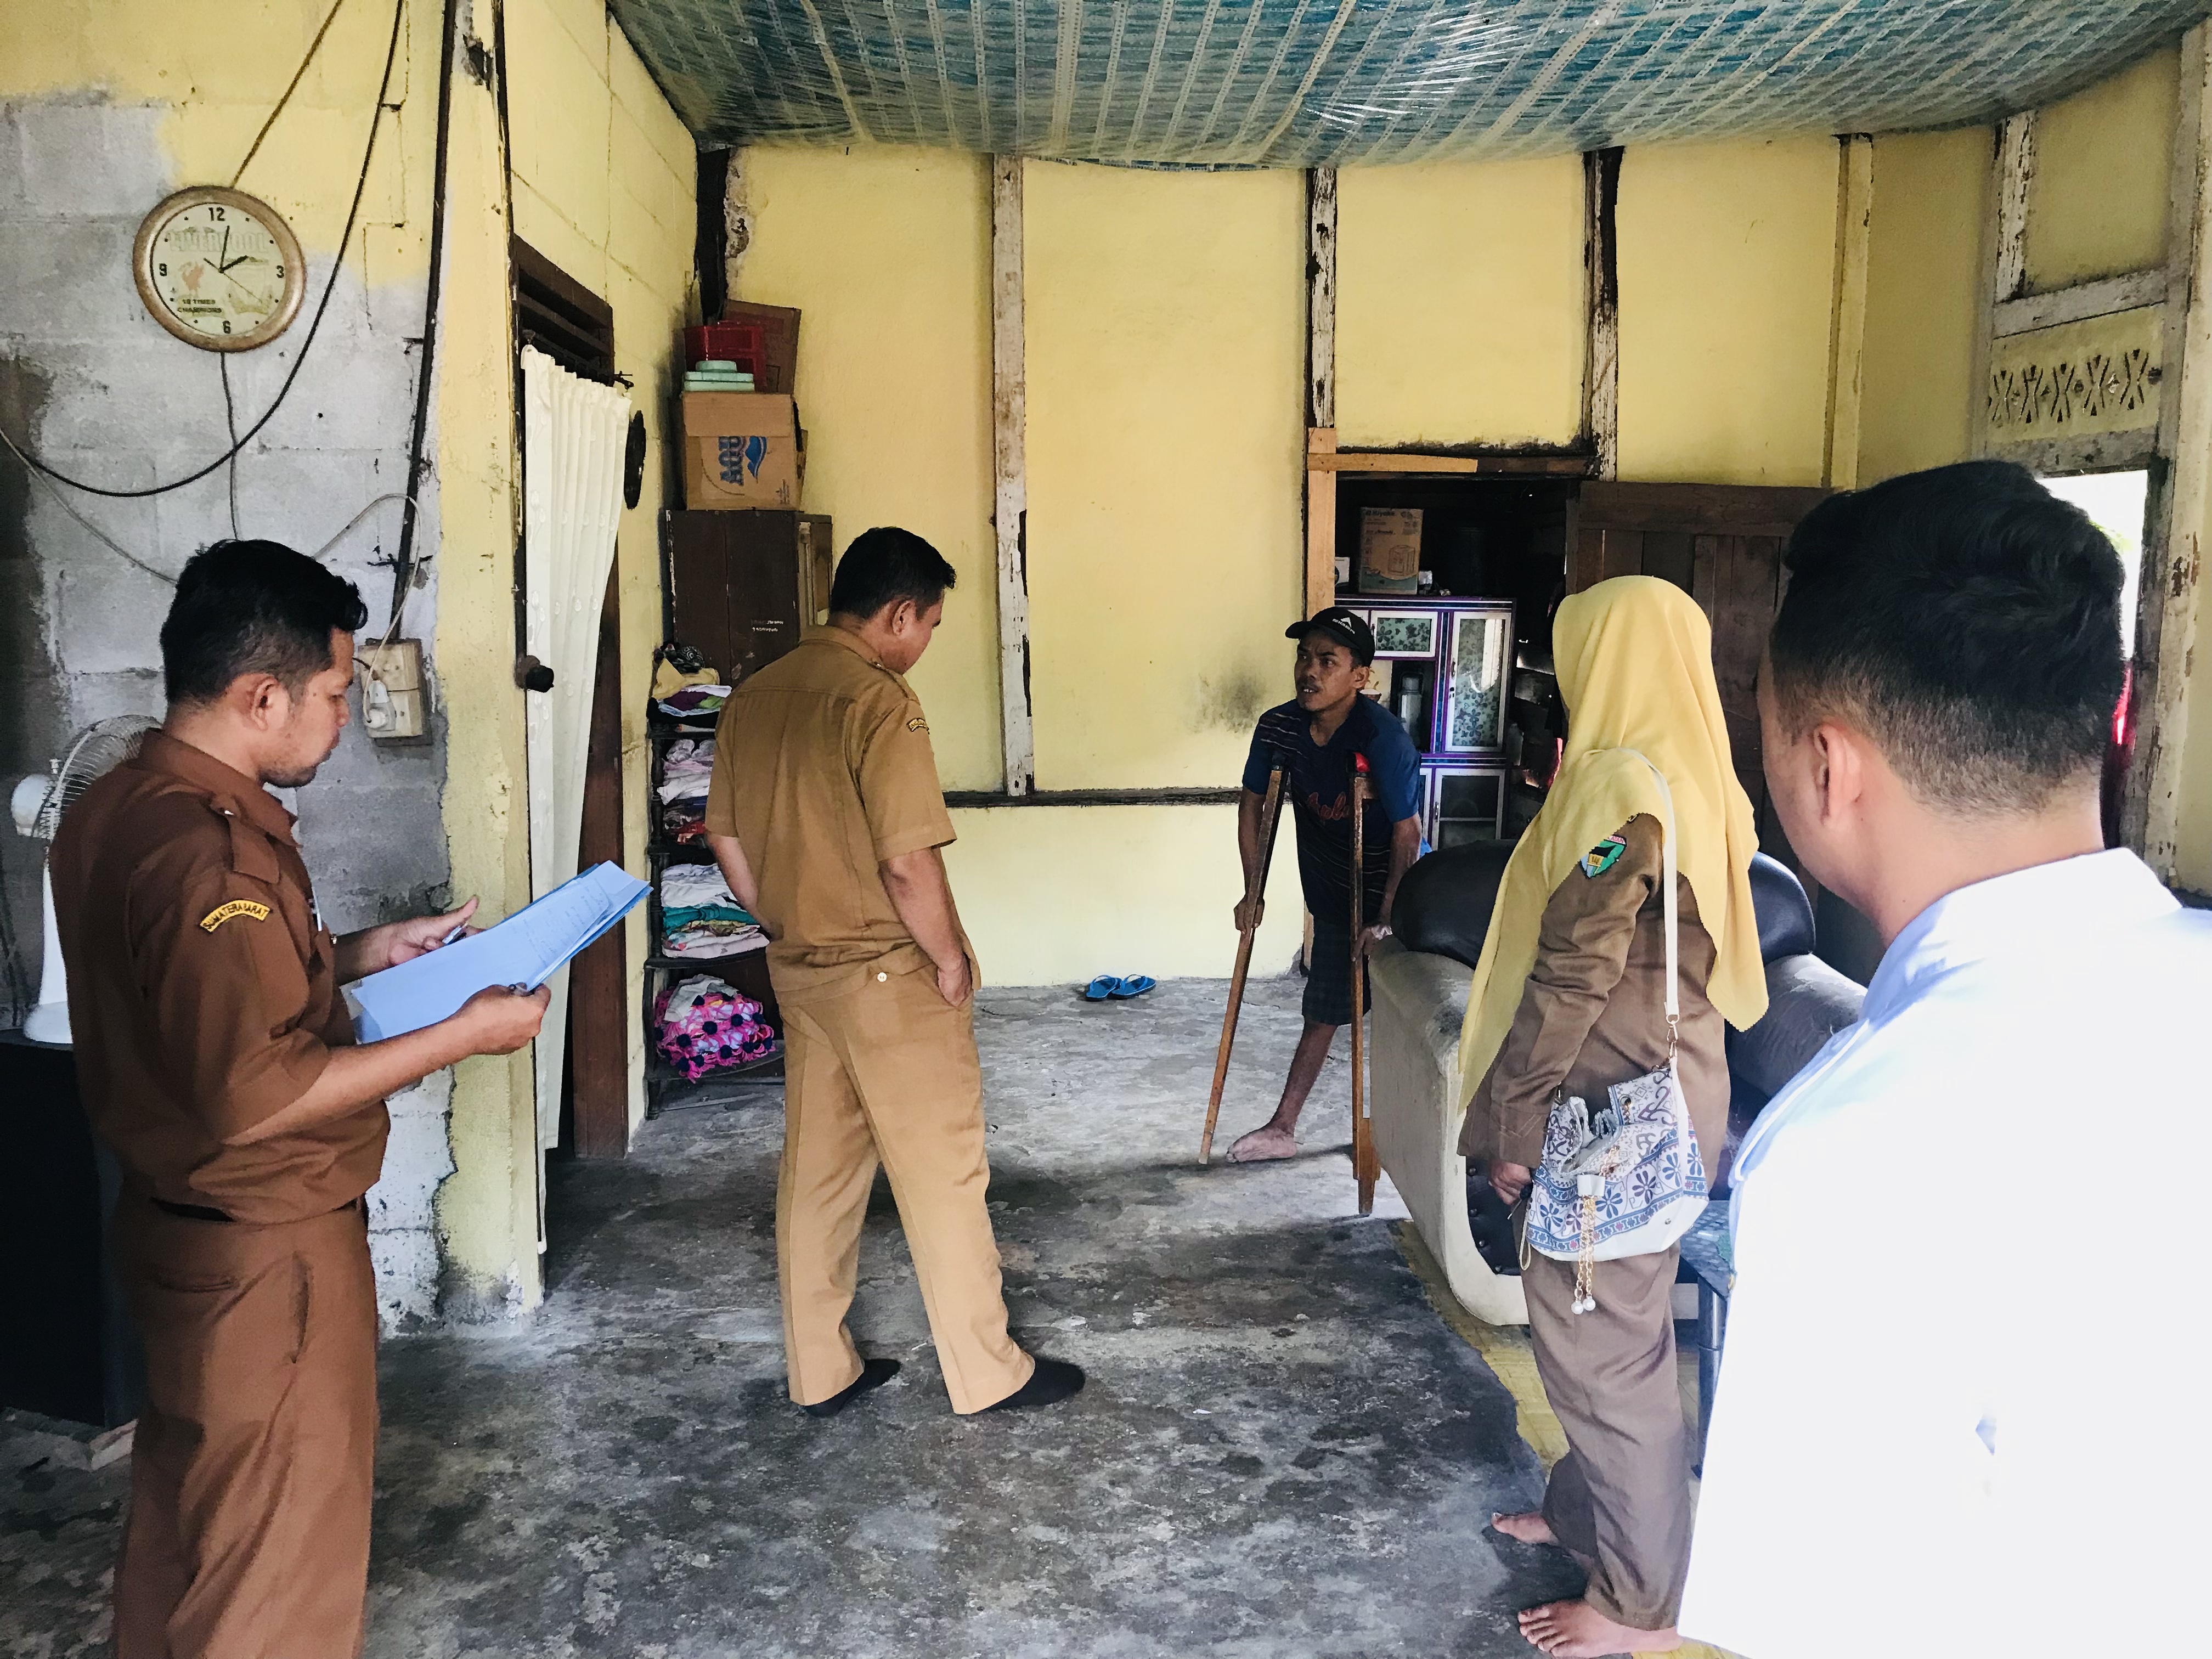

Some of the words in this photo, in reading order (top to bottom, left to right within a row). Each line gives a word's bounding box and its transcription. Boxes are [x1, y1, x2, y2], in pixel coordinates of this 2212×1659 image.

[208, 207, 225, 221] 12
[159, 263, 167, 276] 9
[276, 265, 284, 278] 3
[222, 320, 231, 334] 6
[718, 436, 744, 486] AQU
